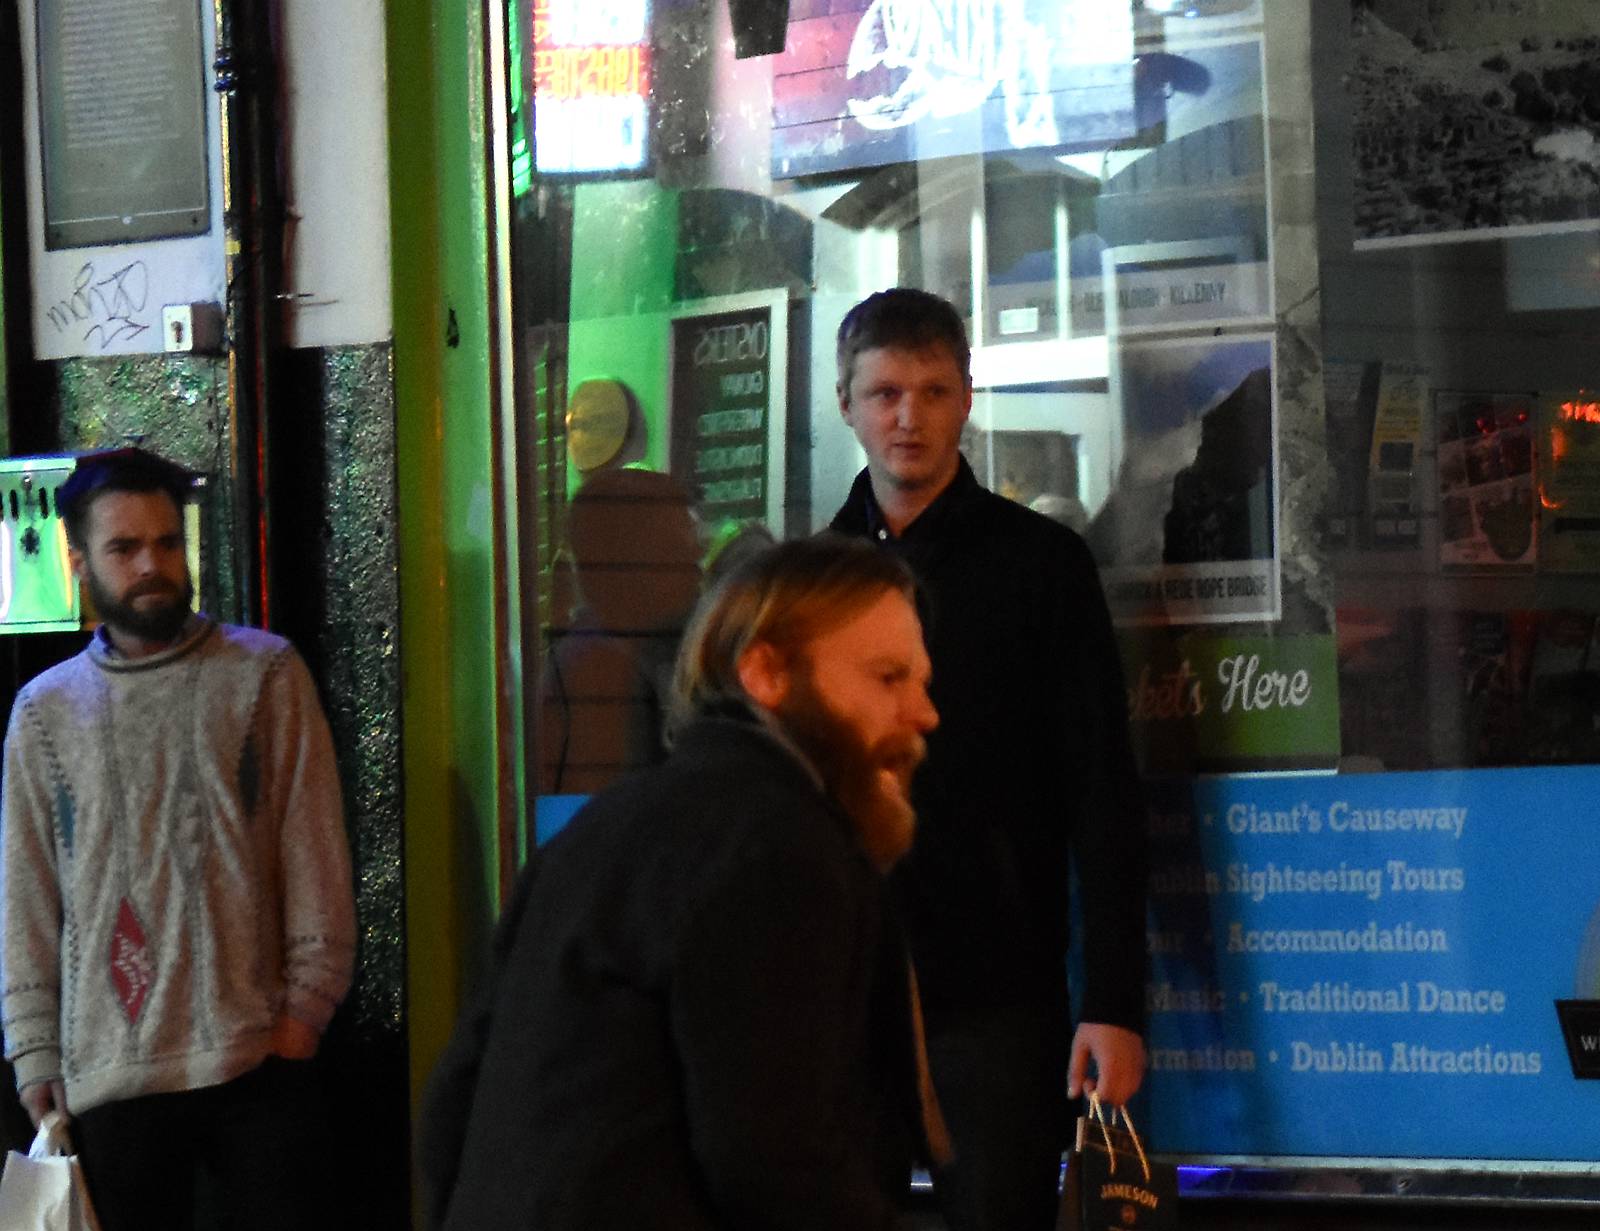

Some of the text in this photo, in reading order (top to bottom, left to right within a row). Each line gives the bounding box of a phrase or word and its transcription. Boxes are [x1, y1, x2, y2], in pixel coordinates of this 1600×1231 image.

[1217, 653, 1313, 713] Here
[1225, 801, 1322, 834] Giant's
[1328, 800, 1468, 839] Causeway
[1149, 859, 1466, 901] ublin Sightseeing Tours
[1225, 921, 1448, 954] Accommodation
[1259, 980, 1410, 1013] Traditional
[1415, 980, 1507, 1014] Dance
[1290, 1040, 1378, 1073] Dublin
[1389, 1042, 1543, 1075] Attractions
[1100, 1182, 1159, 1210] JAMESON
